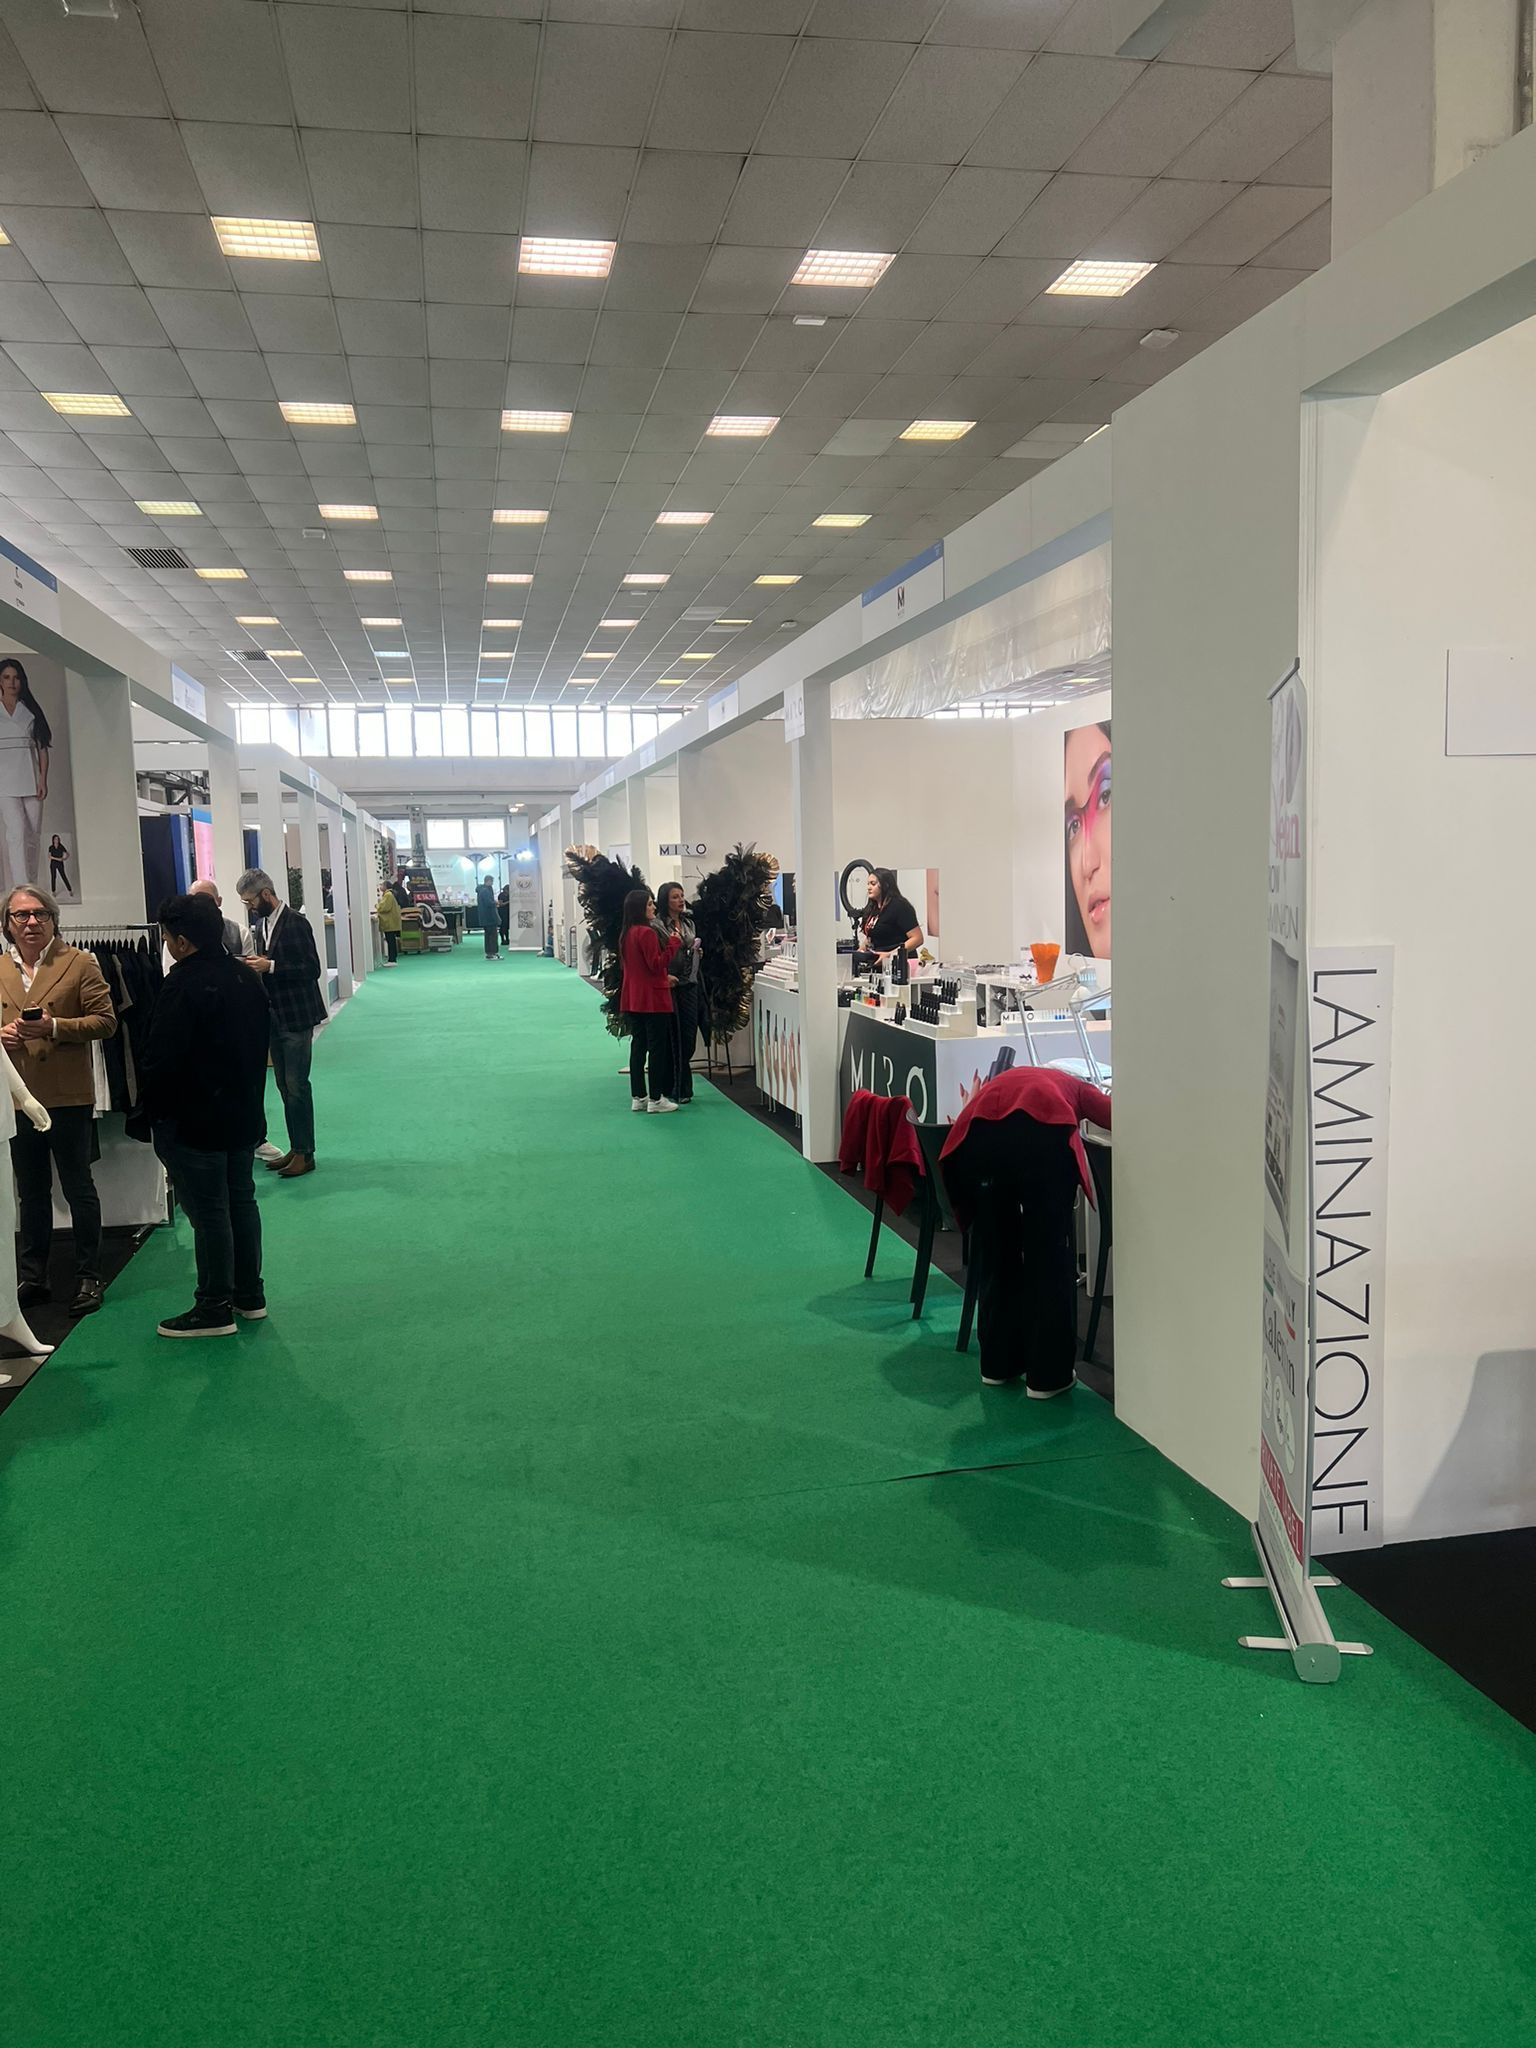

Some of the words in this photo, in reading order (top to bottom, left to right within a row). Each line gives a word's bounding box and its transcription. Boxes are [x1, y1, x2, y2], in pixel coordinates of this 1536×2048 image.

[659, 843, 707, 856] MIRO
[1002, 1012, 1035, 1022] MIO
[850, 1043, 928, 1123] MIRO
[1306, 968, 1377, 1535] LAMINAZIONE
